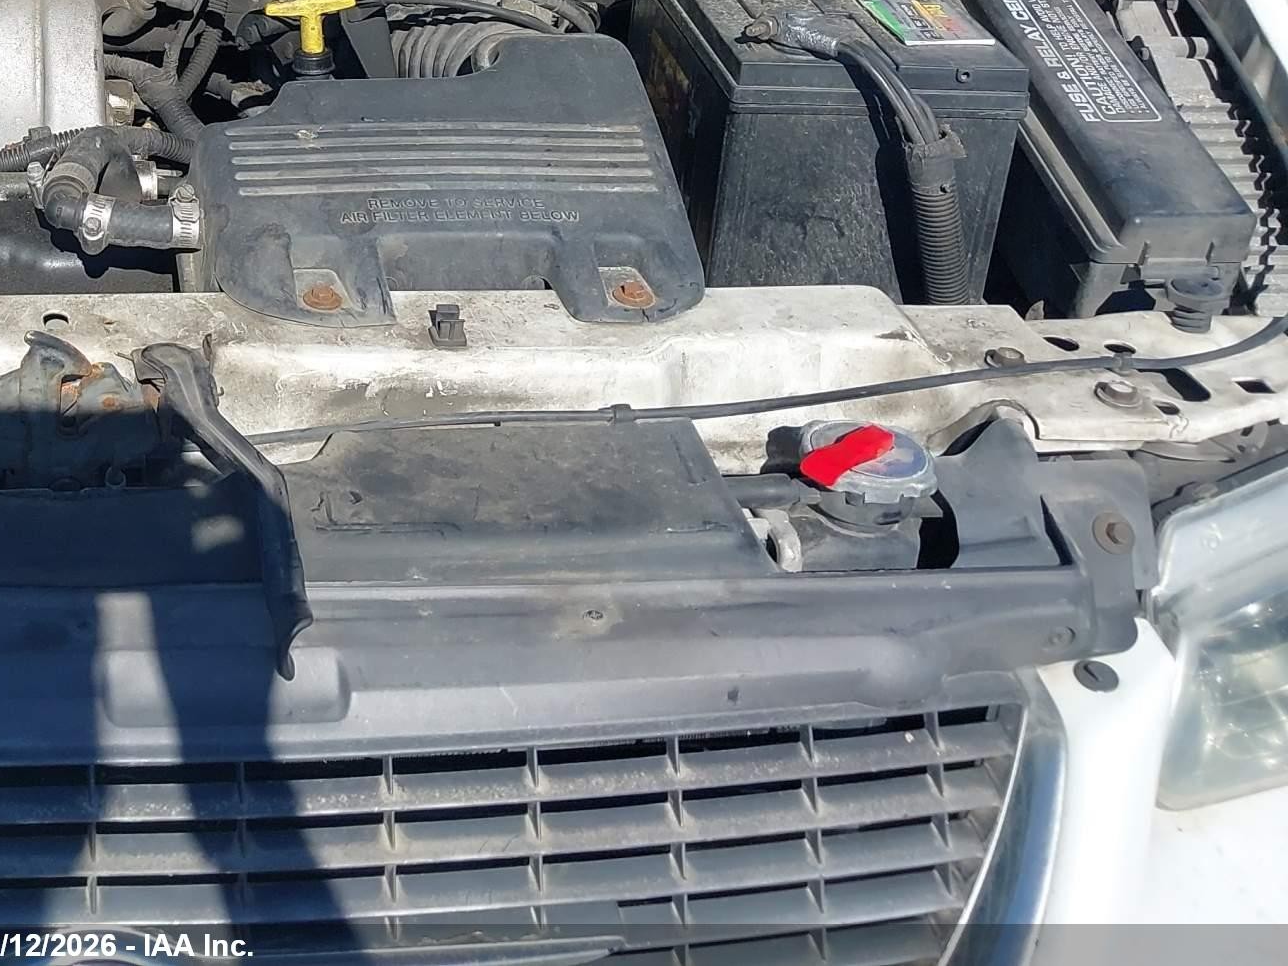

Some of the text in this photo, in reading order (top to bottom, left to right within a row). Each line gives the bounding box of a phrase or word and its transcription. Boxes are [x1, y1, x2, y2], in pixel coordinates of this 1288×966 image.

[1030, 4, 1051, 22] AVOID
[1044, 23, 1063, 39] HELP
[1055, 25, 1081, 49] ENGINE
[1019, 23, 1063, 66] RELAY
[1055, 71, 1071, 79] &
[1064, 54, 1117, 113] CAUTION!
[1061, 84, 1098, 121] FUSE
[1095, 81, 1126, 112] DAMAGE
[367, 197, 546, 211] REMOVE TO SERVICE
[340, 209, 580, 224] AIR FILTER ELEMENT BELOW
